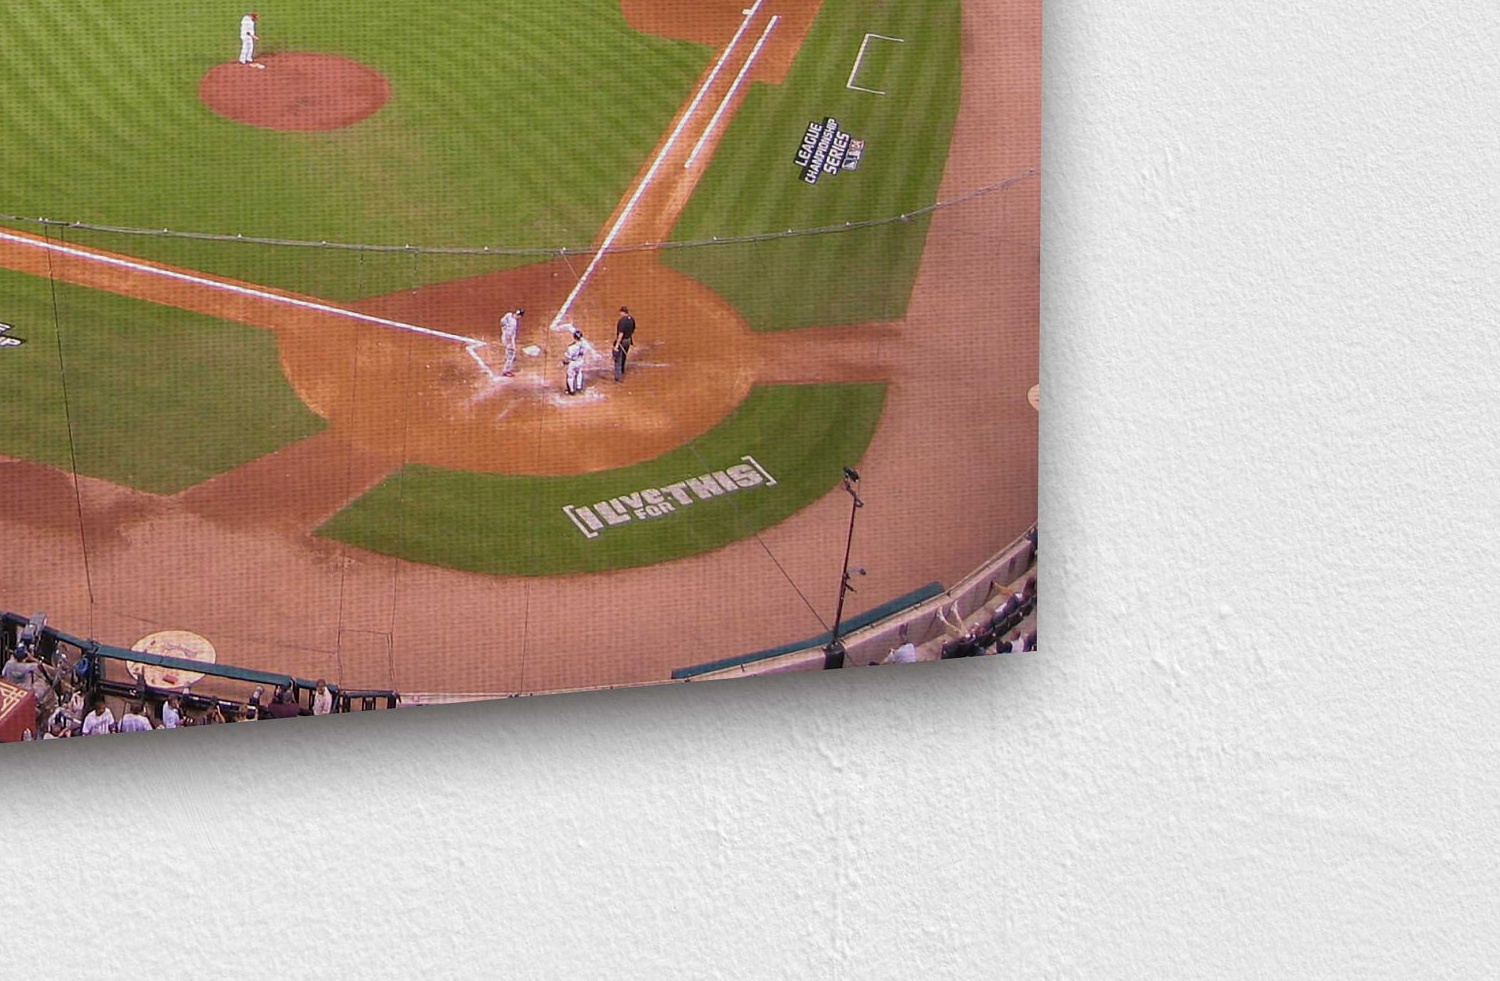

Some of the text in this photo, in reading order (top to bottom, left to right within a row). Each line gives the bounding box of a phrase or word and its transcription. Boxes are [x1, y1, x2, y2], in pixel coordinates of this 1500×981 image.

[795, 122, 823, 167] LEAGUE
[804, 118, 838, 184] CHAMPIONSHIP
[823, 131, 850, 175] SERIES
[634, 501, 676, 520] FOR
